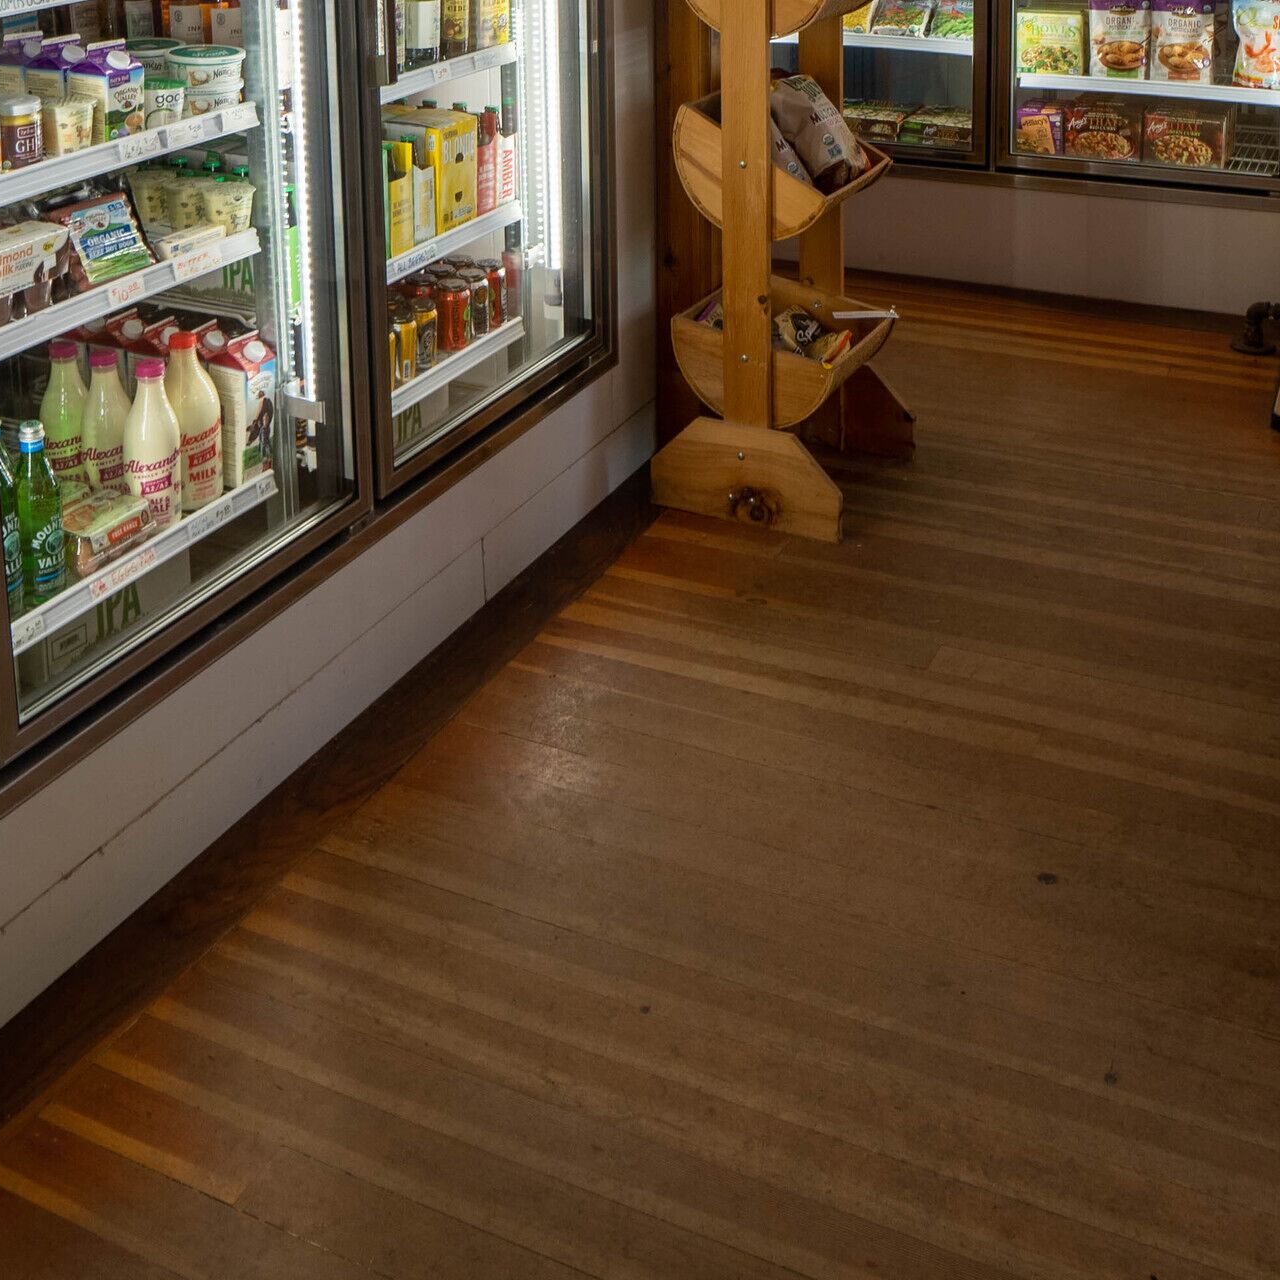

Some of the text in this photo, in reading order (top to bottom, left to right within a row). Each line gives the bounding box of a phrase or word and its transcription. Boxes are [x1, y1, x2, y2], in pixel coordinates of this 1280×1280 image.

[1168, 18, 1201, 28] ORGANIC
[441, 136, 476, 164] BLONDE
[501, 148, 513, 200] AMBER
[87, 227, 128, 244] ORGANIC
[223, 259, 254, 297] IPA
[189, 468, 217, 482] MILK
[96, 582, 141, 637] IPA
